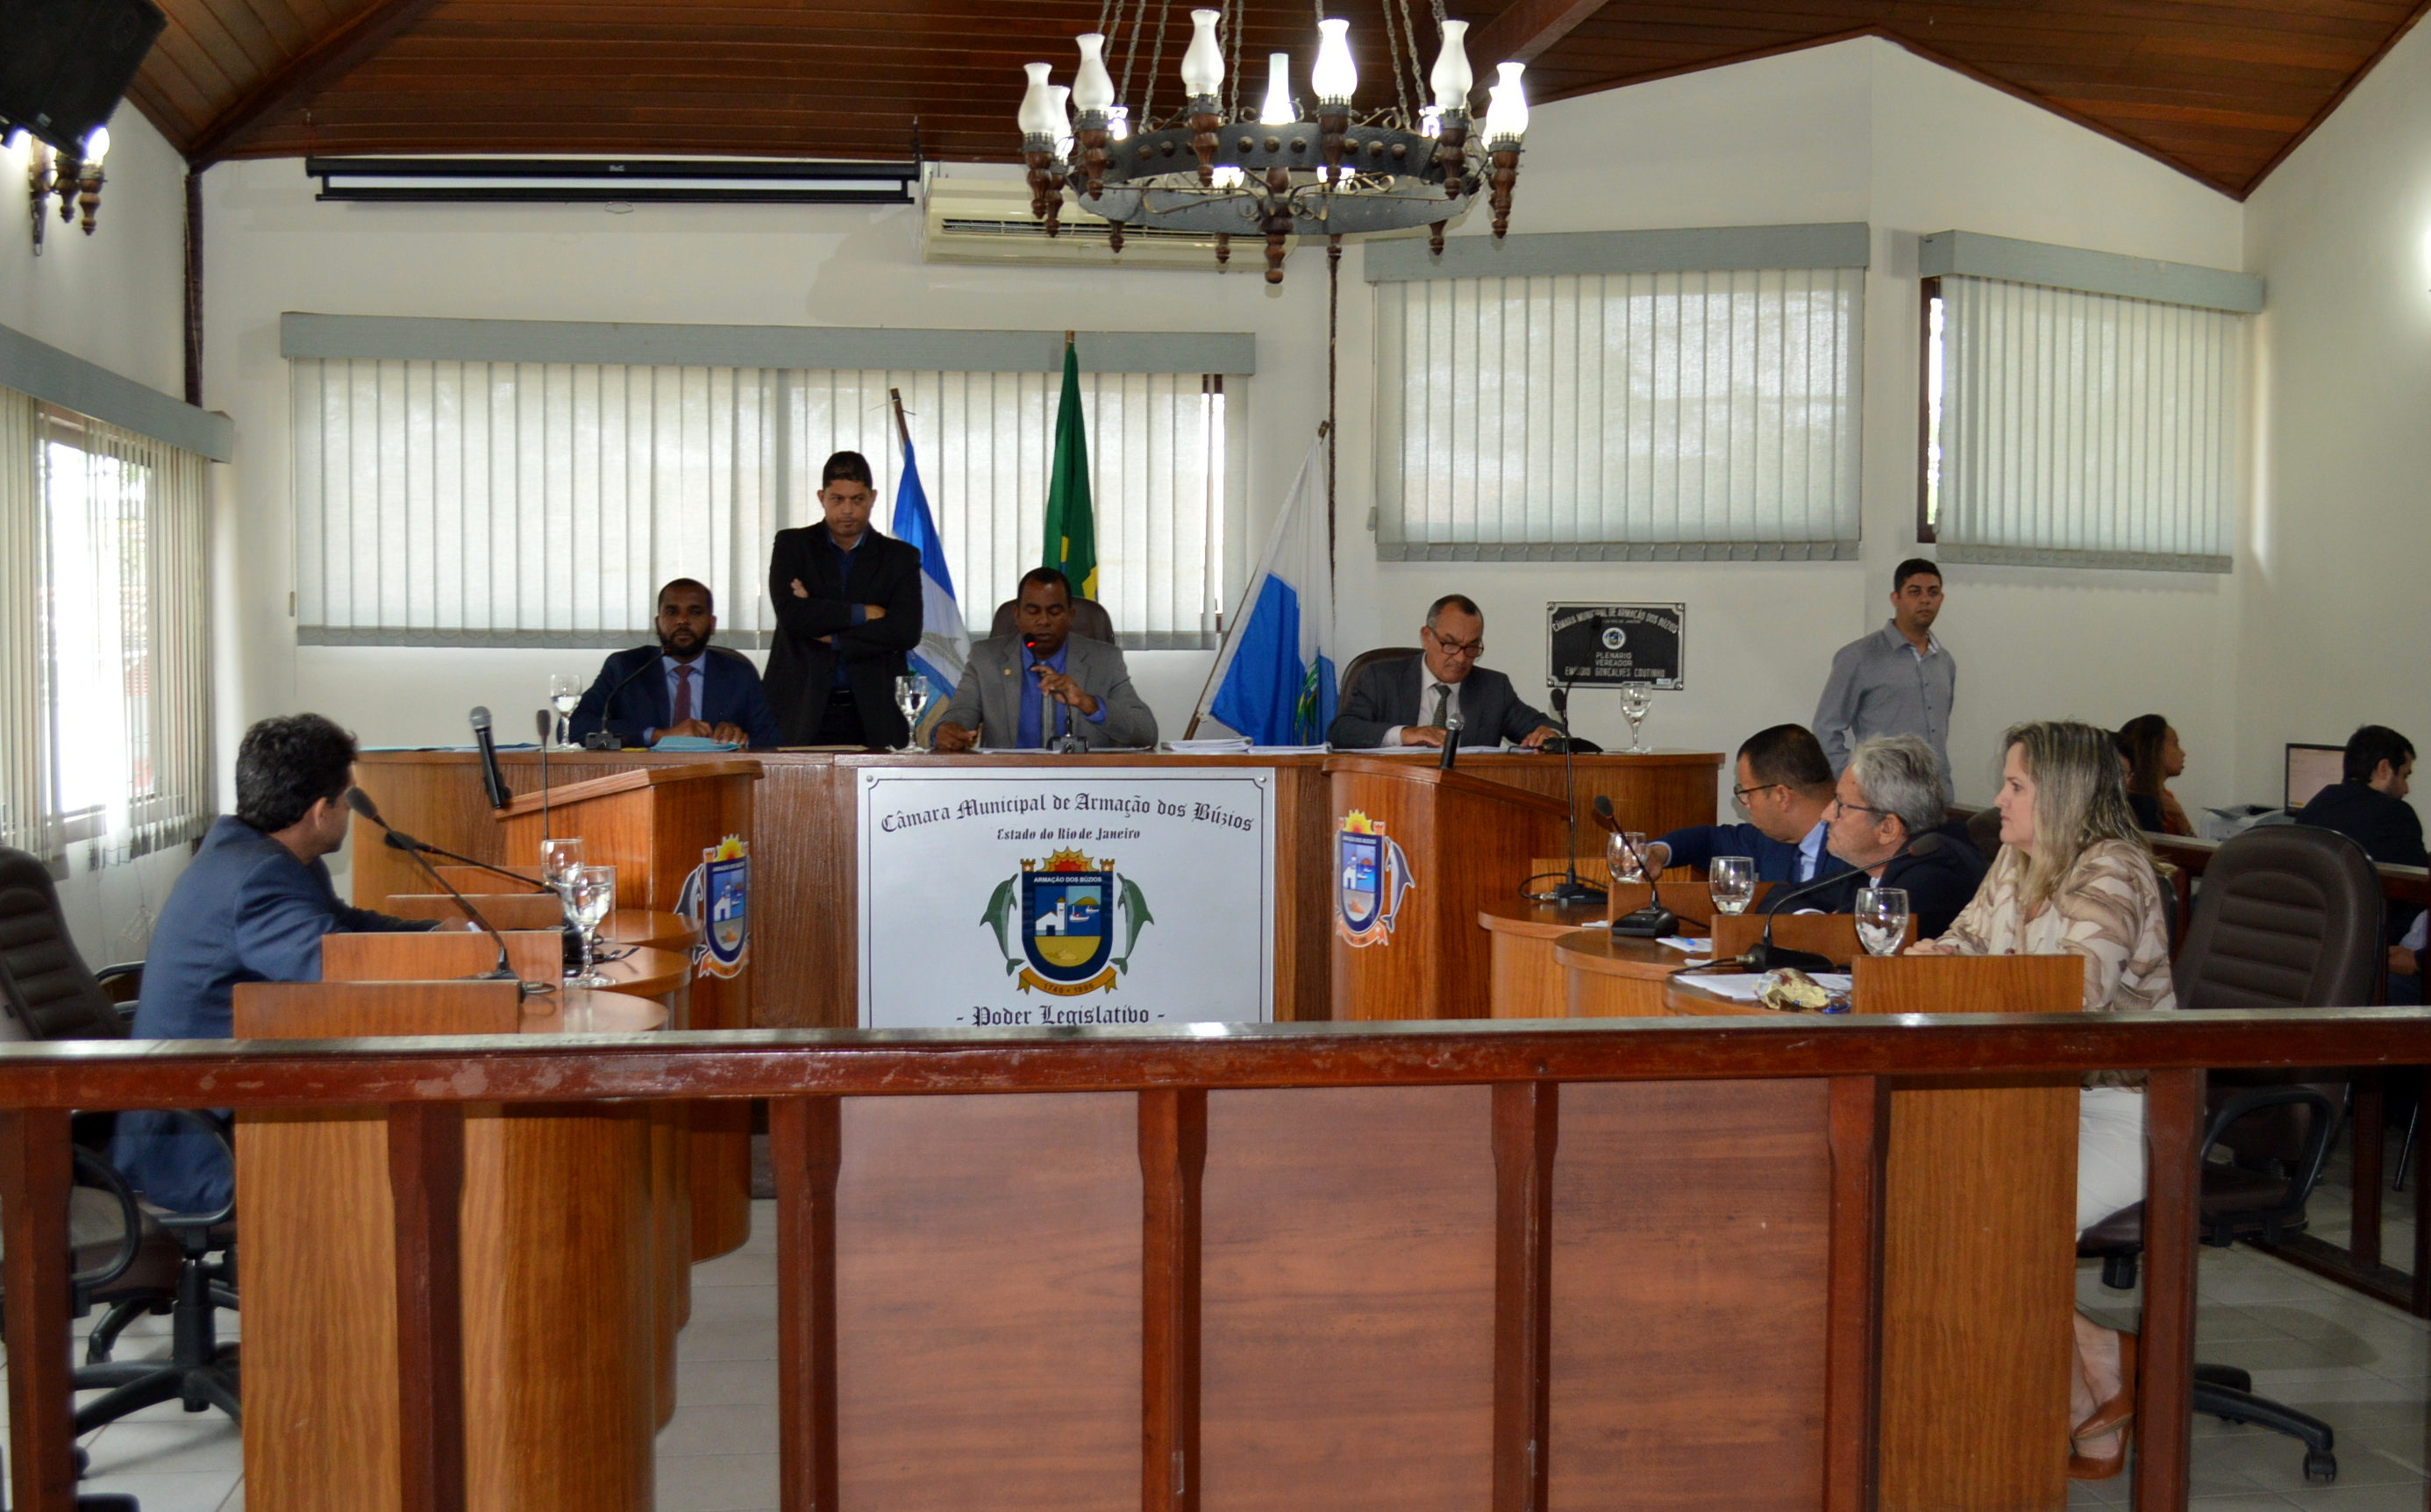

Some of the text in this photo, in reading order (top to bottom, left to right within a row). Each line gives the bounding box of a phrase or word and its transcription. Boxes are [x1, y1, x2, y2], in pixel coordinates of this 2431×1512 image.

[1552, 616, 1577, 631] CÂMARA
[1608, 608, 1617, 617] DE
[1645, 613, 1658, 624] DOS
[1595, 667, 1630, 677] GONÇALVES
[1635, 668, 1665, 677] COUTINHO
[880, 793, 1255, 833] Câmara Municipal de Armação dos Búzios
[996, 827, 1037, 840] Estado
[1039, 827, 1054, 840] do
[1095, 827, 1141, 841] Janeiro
[1033, 875, 1065, 885] ARMAÇÃO
[1080, 875, 1102, 884] BÚZIOS
[1044, 983, 1094, 994] 1740 1995
[972, 1006, 1031, 1026] Poder
[1039, 1005, 1149, 1025] Legislativo
